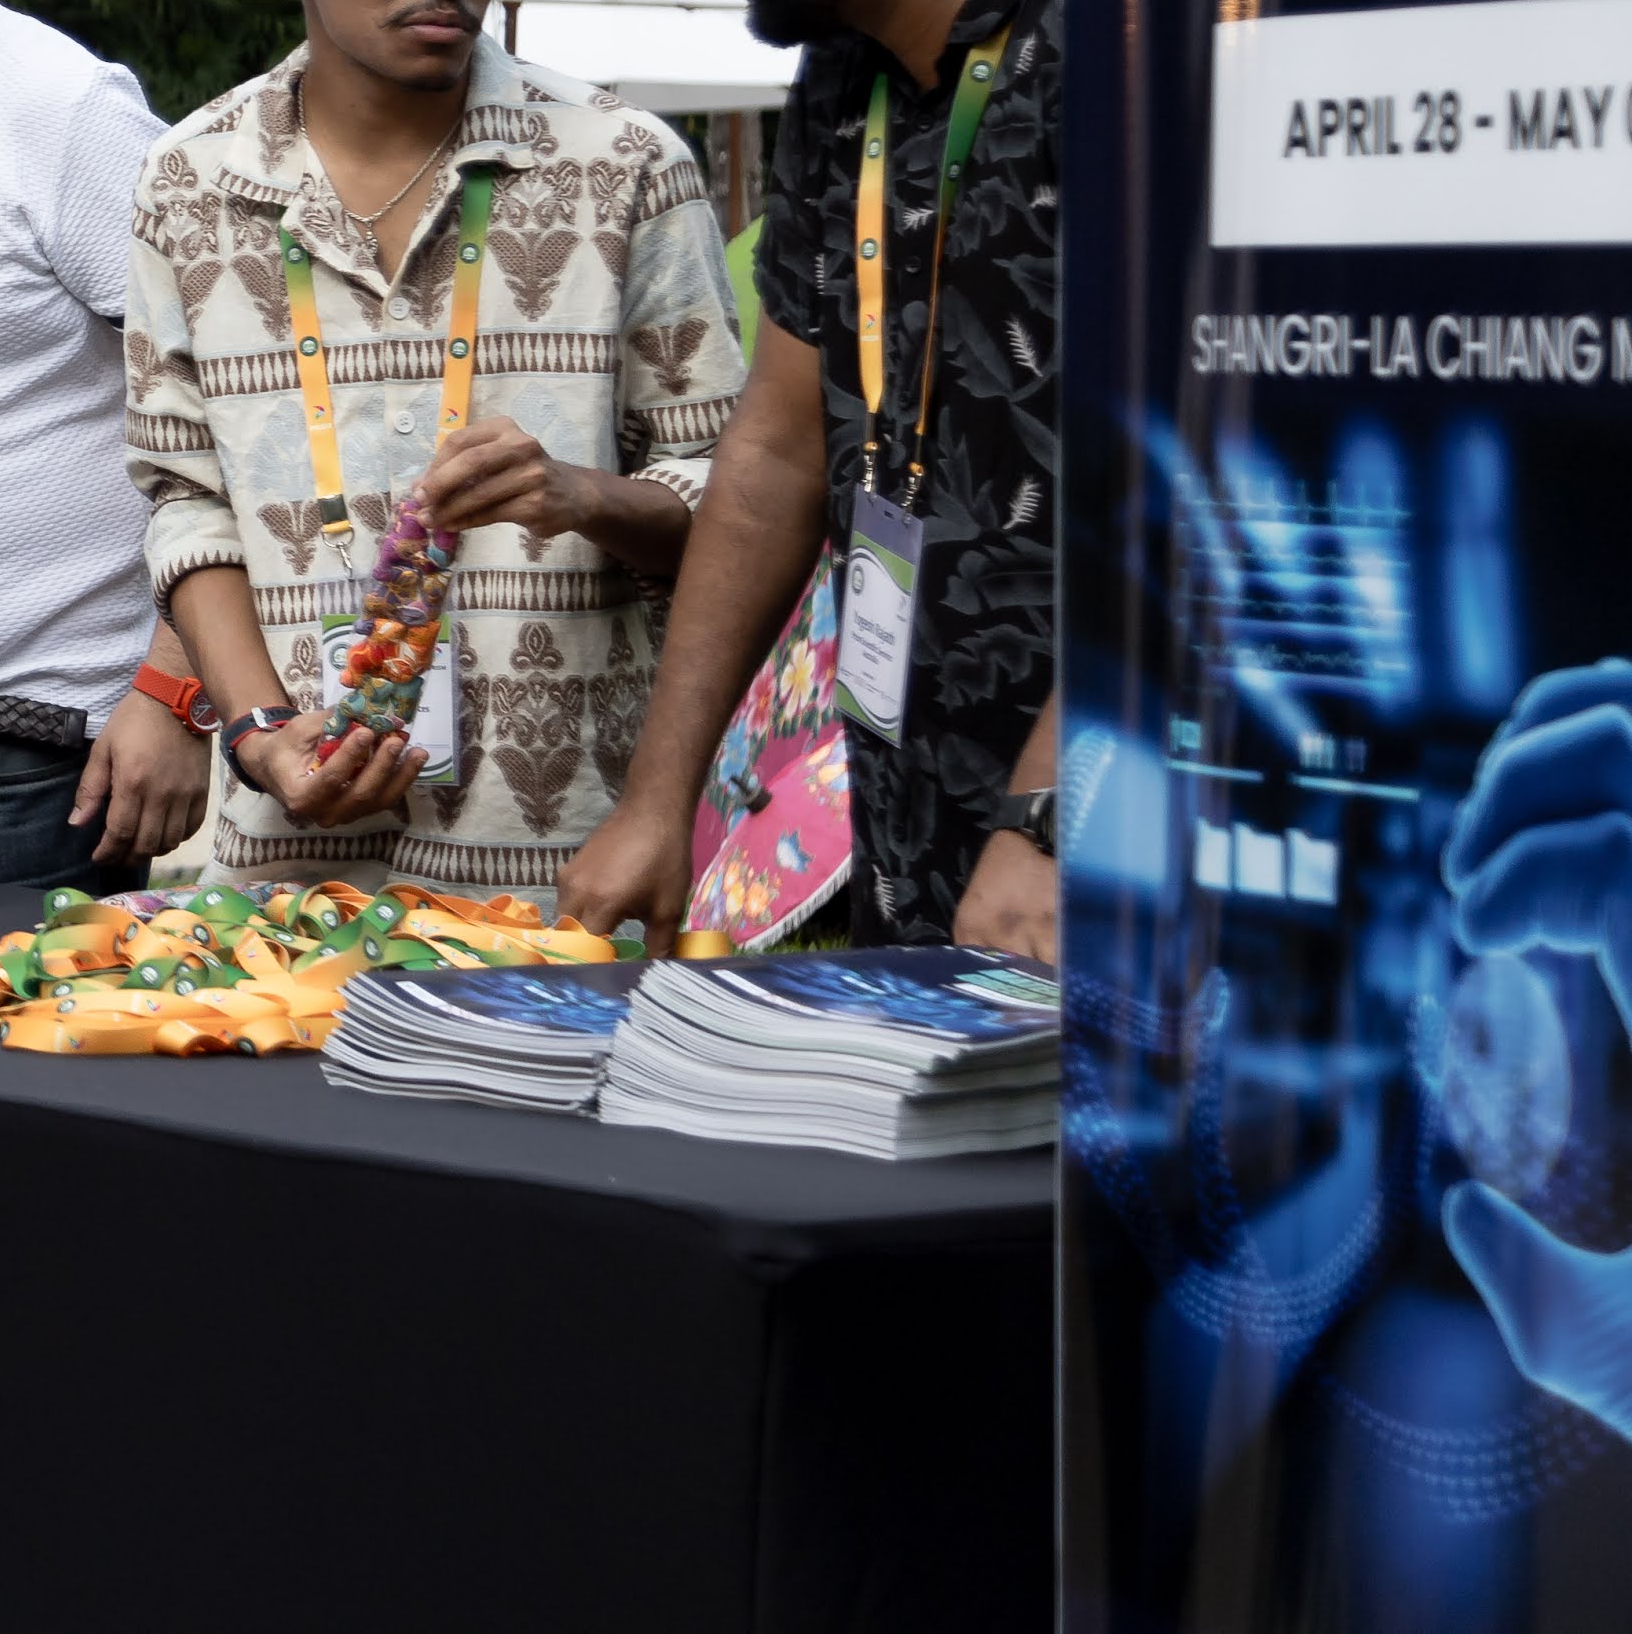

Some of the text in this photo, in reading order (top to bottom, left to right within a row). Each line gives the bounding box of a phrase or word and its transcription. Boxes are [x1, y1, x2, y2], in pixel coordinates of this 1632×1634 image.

[1283, 93, 1401, 160] APRIL
[1413, 91, 1464, 155] 28
[1505, 83, 1615, 151] MAY
[1190, 312, 1421, 377] SHANGRI-LA
[1424, 314, 1603, 384] CHIANG
